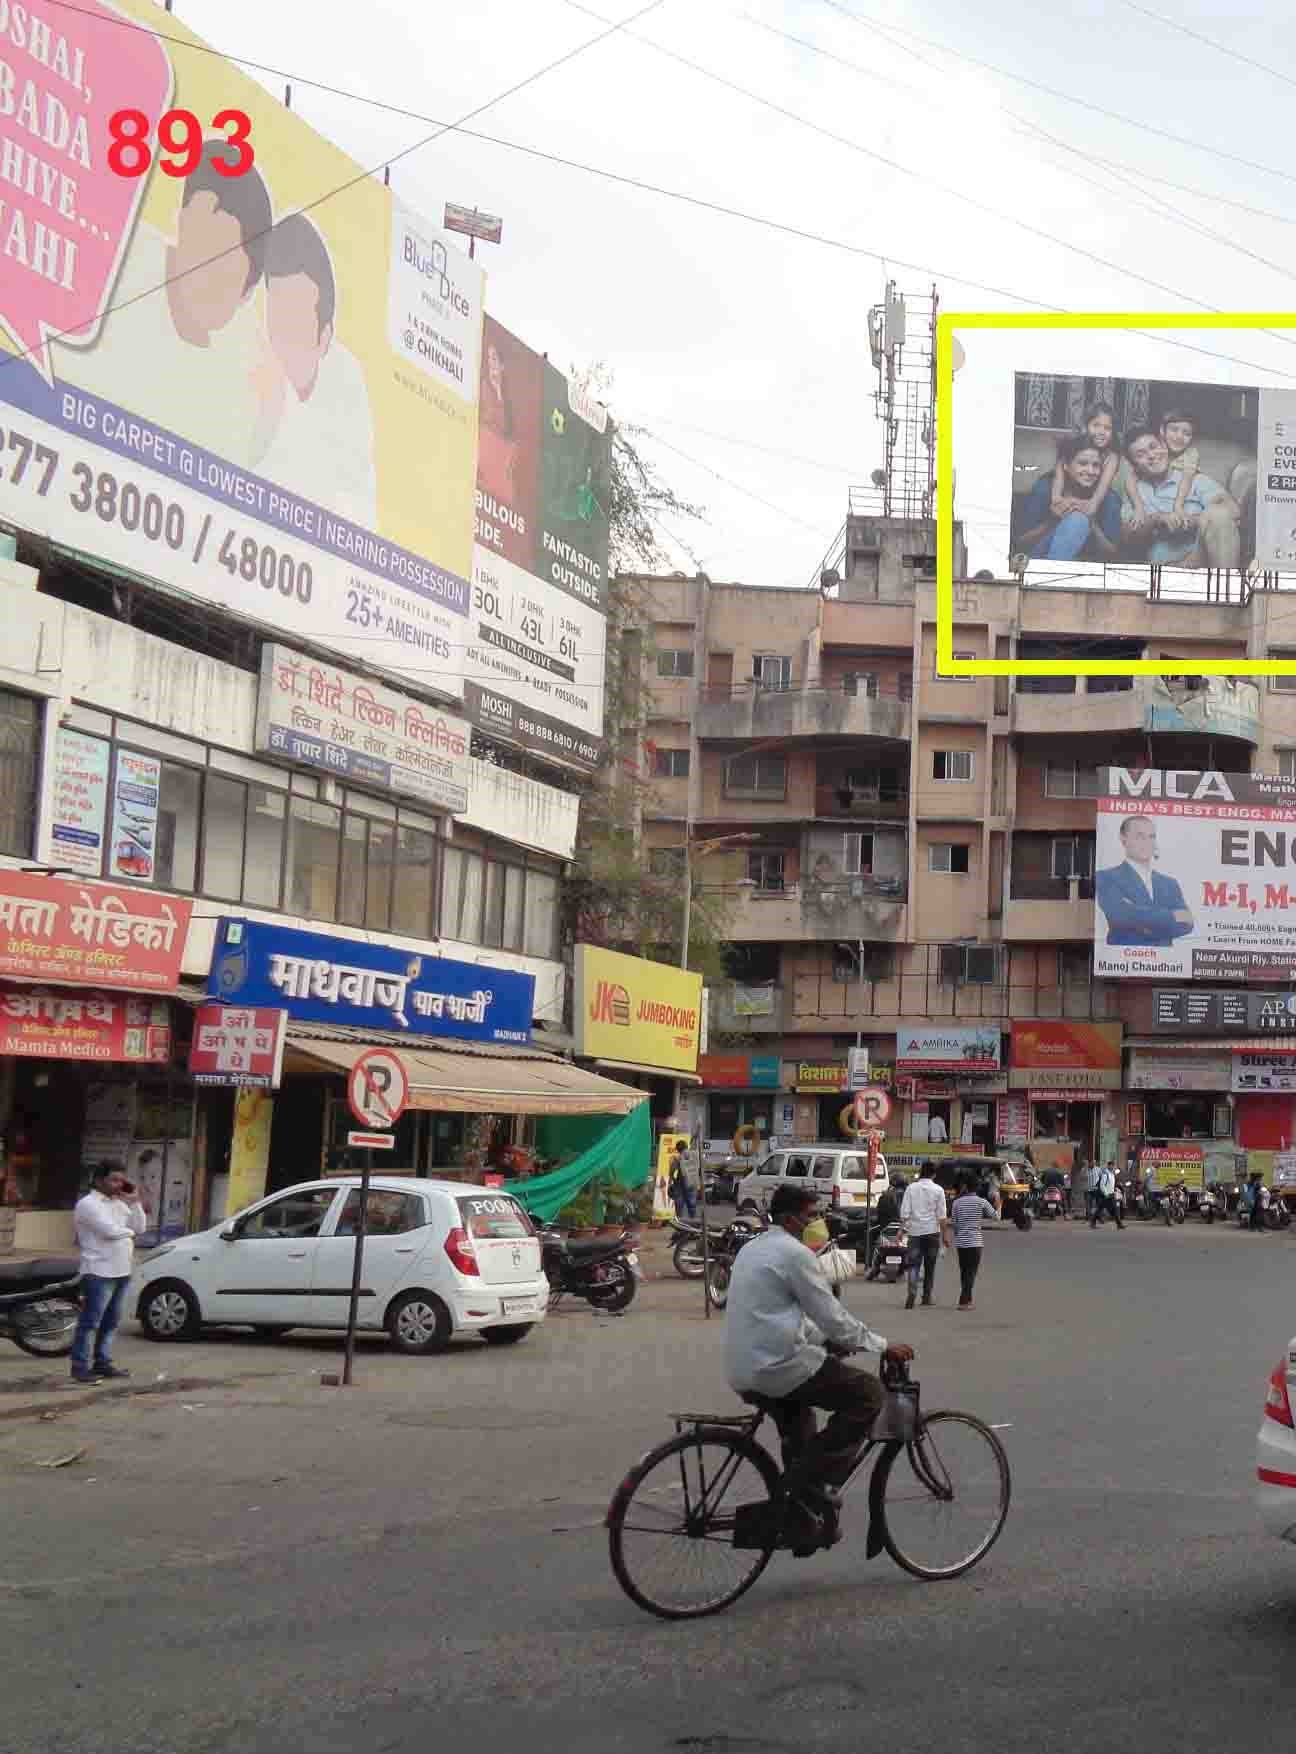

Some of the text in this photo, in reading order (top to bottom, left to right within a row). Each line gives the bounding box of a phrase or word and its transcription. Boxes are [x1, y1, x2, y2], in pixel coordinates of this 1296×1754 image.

[0, 0, 92, 103] SHAI,
[403, 329, 464, 383] @ CHIKHALI
[1270, 476, 1281, 487] 2
[62, 394, 97, 429] BIG
[102, 413, 176, 465] CARPET
[180, 449, 193, 475] @
[198, 458, 266, 510] LOWEST
[268, 493, 313, 533] PRICE
[326, 519, 387, 567] NEARING
[391, 552, 464, 605] POSSESSION
[70, 461, 185, 550] 38000
[192, 514, 213, 564] /
[218, 529, 313, 604] 48000
[543, 530, 601, 578] FANTASTIC
[345, 589, 384, 627] 25+
[386, 616, 450, 659] AMENITIES
[520, 615, 545, 645] 43L
[489, 632, 552, 670] ALL INCLUSIVE
[559, 636, 580, 663] 61L
[351, 685, 397, 732] स्किन
[481, 691, 513, 719] MOSHI
[270, 725, 289, 749] डॉ.
[518, 717, 535, 735] 888
[536, 724, 553, 741] 888
[553, 732, 573, 749] 6810
[1108, 766, 1236, 801] MCA
[1109, 800, 1168, 814] INDIA'S
[1172, 803, 1214, 817] BEST
[1202, 879, 1258, 914] M-I,
[70, 890, 178, 952] मेडिको
[1123, 948, 1157, 960] Coach
[1195, 952, 1218, 963] Near
[1219, 953, 1250, 964] Akurdi
[1260, 938, 1283, 946] HOME
[1098, 960, 1184, 975] Manoj Chaudhari
[412, 990, 444, 1018] पाव
[447, 988, 494, 1024] भाजी
[590, 979, 614, 1024] JK
[636, 1000, 696, 1030] JUMBOKING
[6, 1037, 112, 1058] Mamta Medico
